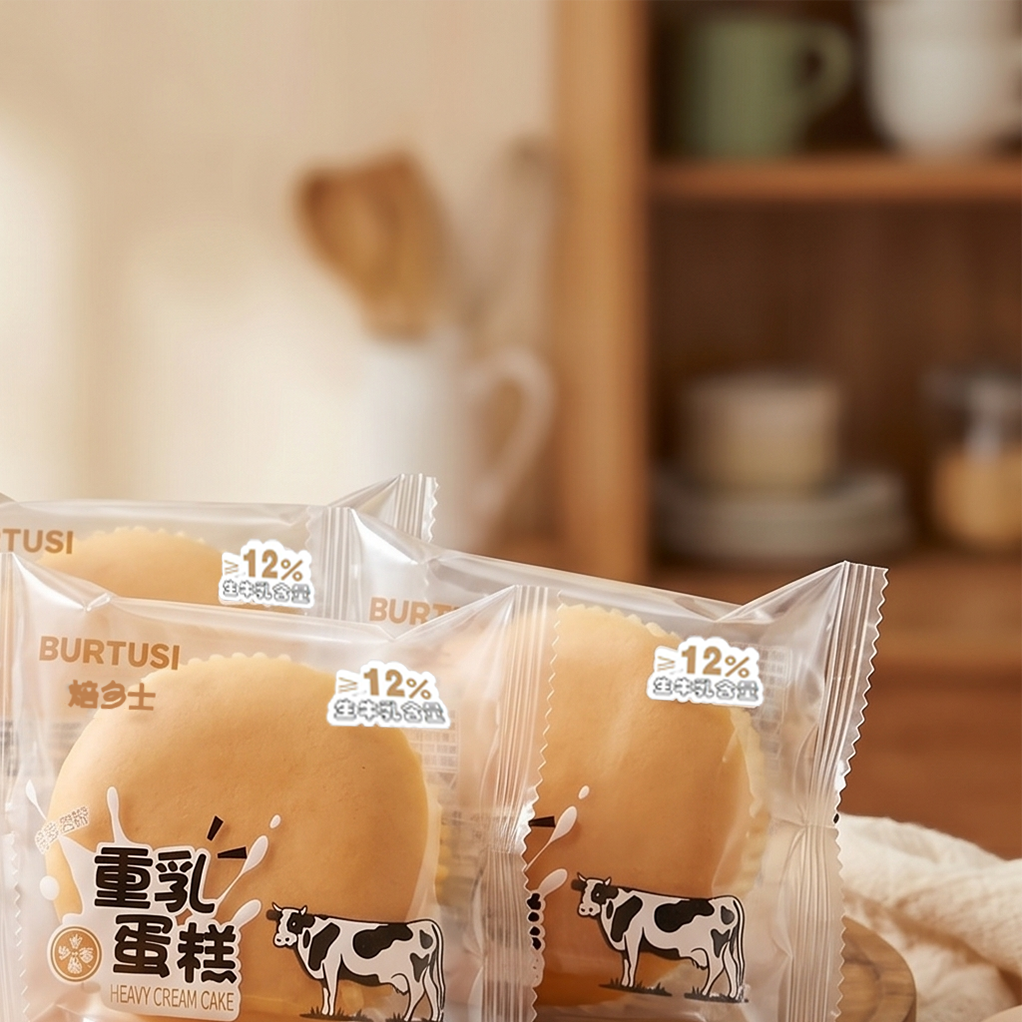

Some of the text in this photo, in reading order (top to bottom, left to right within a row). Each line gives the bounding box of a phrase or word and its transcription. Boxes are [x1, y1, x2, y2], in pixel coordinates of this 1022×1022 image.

[369, 597, 461, 626] BURT
[39, 636, 180, 670] BURTUSI
[94, 847, 215, 913] 重乳
[113, 914, 237, 984] 蛋糕
[110, 984, 235, 1012] HEAVY CREAM CAKE
